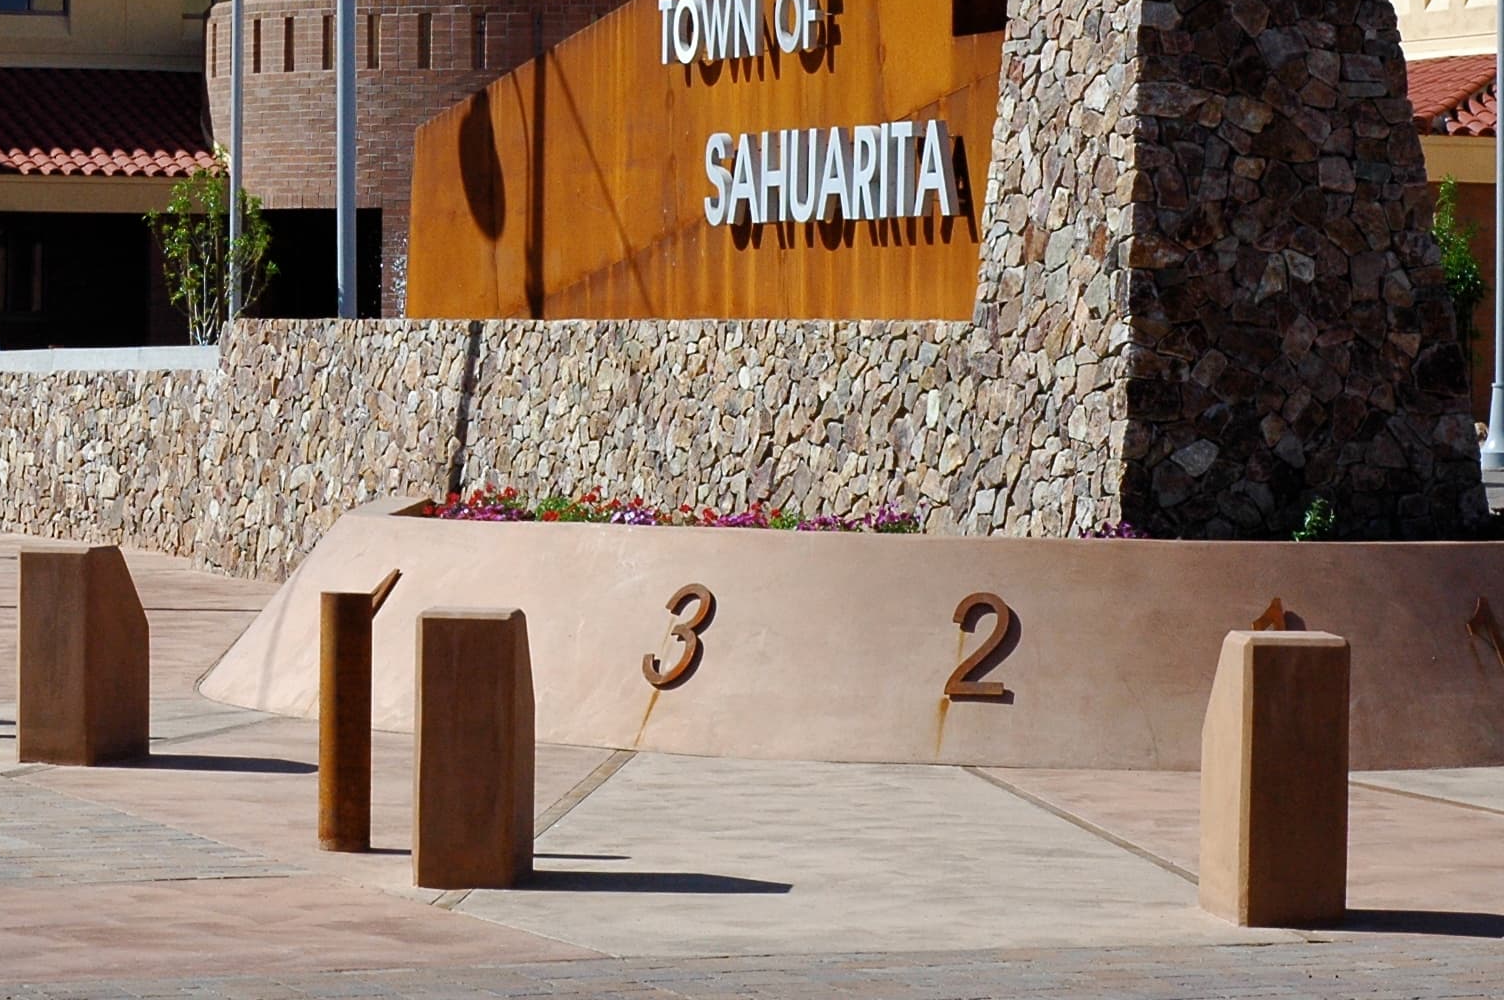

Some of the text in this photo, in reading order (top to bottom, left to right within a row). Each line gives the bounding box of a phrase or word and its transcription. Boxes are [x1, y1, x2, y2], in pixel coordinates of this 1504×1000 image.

[704, 119, 959, 226] SAHUARITA
[642, 583, 712, 687] 3
[944, 592, 1012, 698] 2
